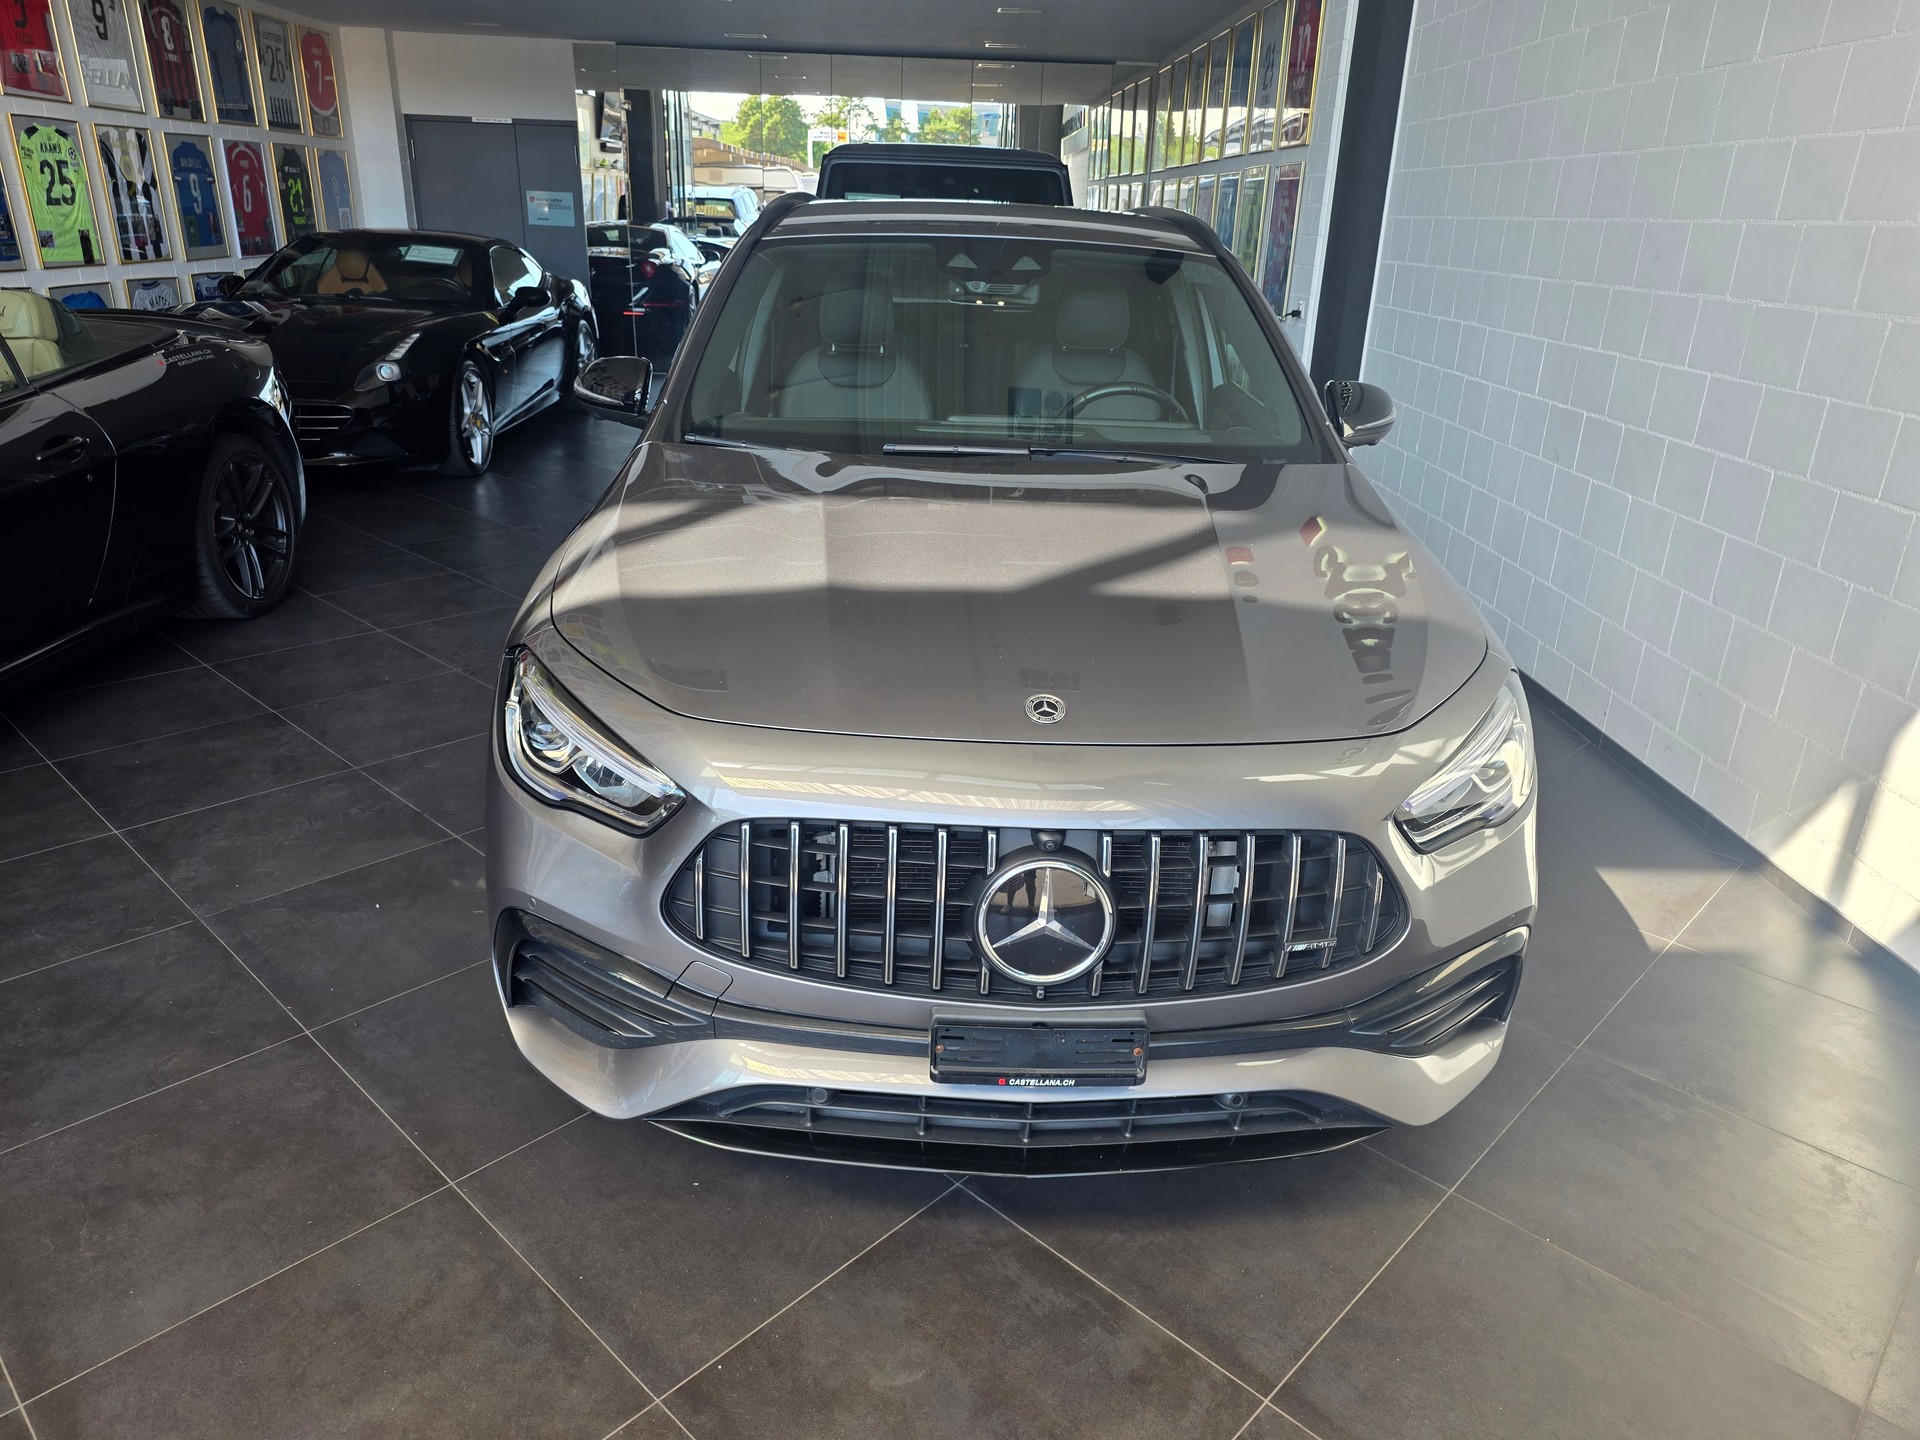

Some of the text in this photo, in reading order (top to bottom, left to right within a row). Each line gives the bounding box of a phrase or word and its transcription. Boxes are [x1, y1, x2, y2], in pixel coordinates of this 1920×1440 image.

[161, 15, 175, 50] 8
[266, 45, 285, 83] 26
[40, 159, 77, 206] 25
[189, 173, 202, 214] 9
[243, 175, 252, 212] 6
[1009, 1079, 1076, 1087] CASTELLANA.CH
